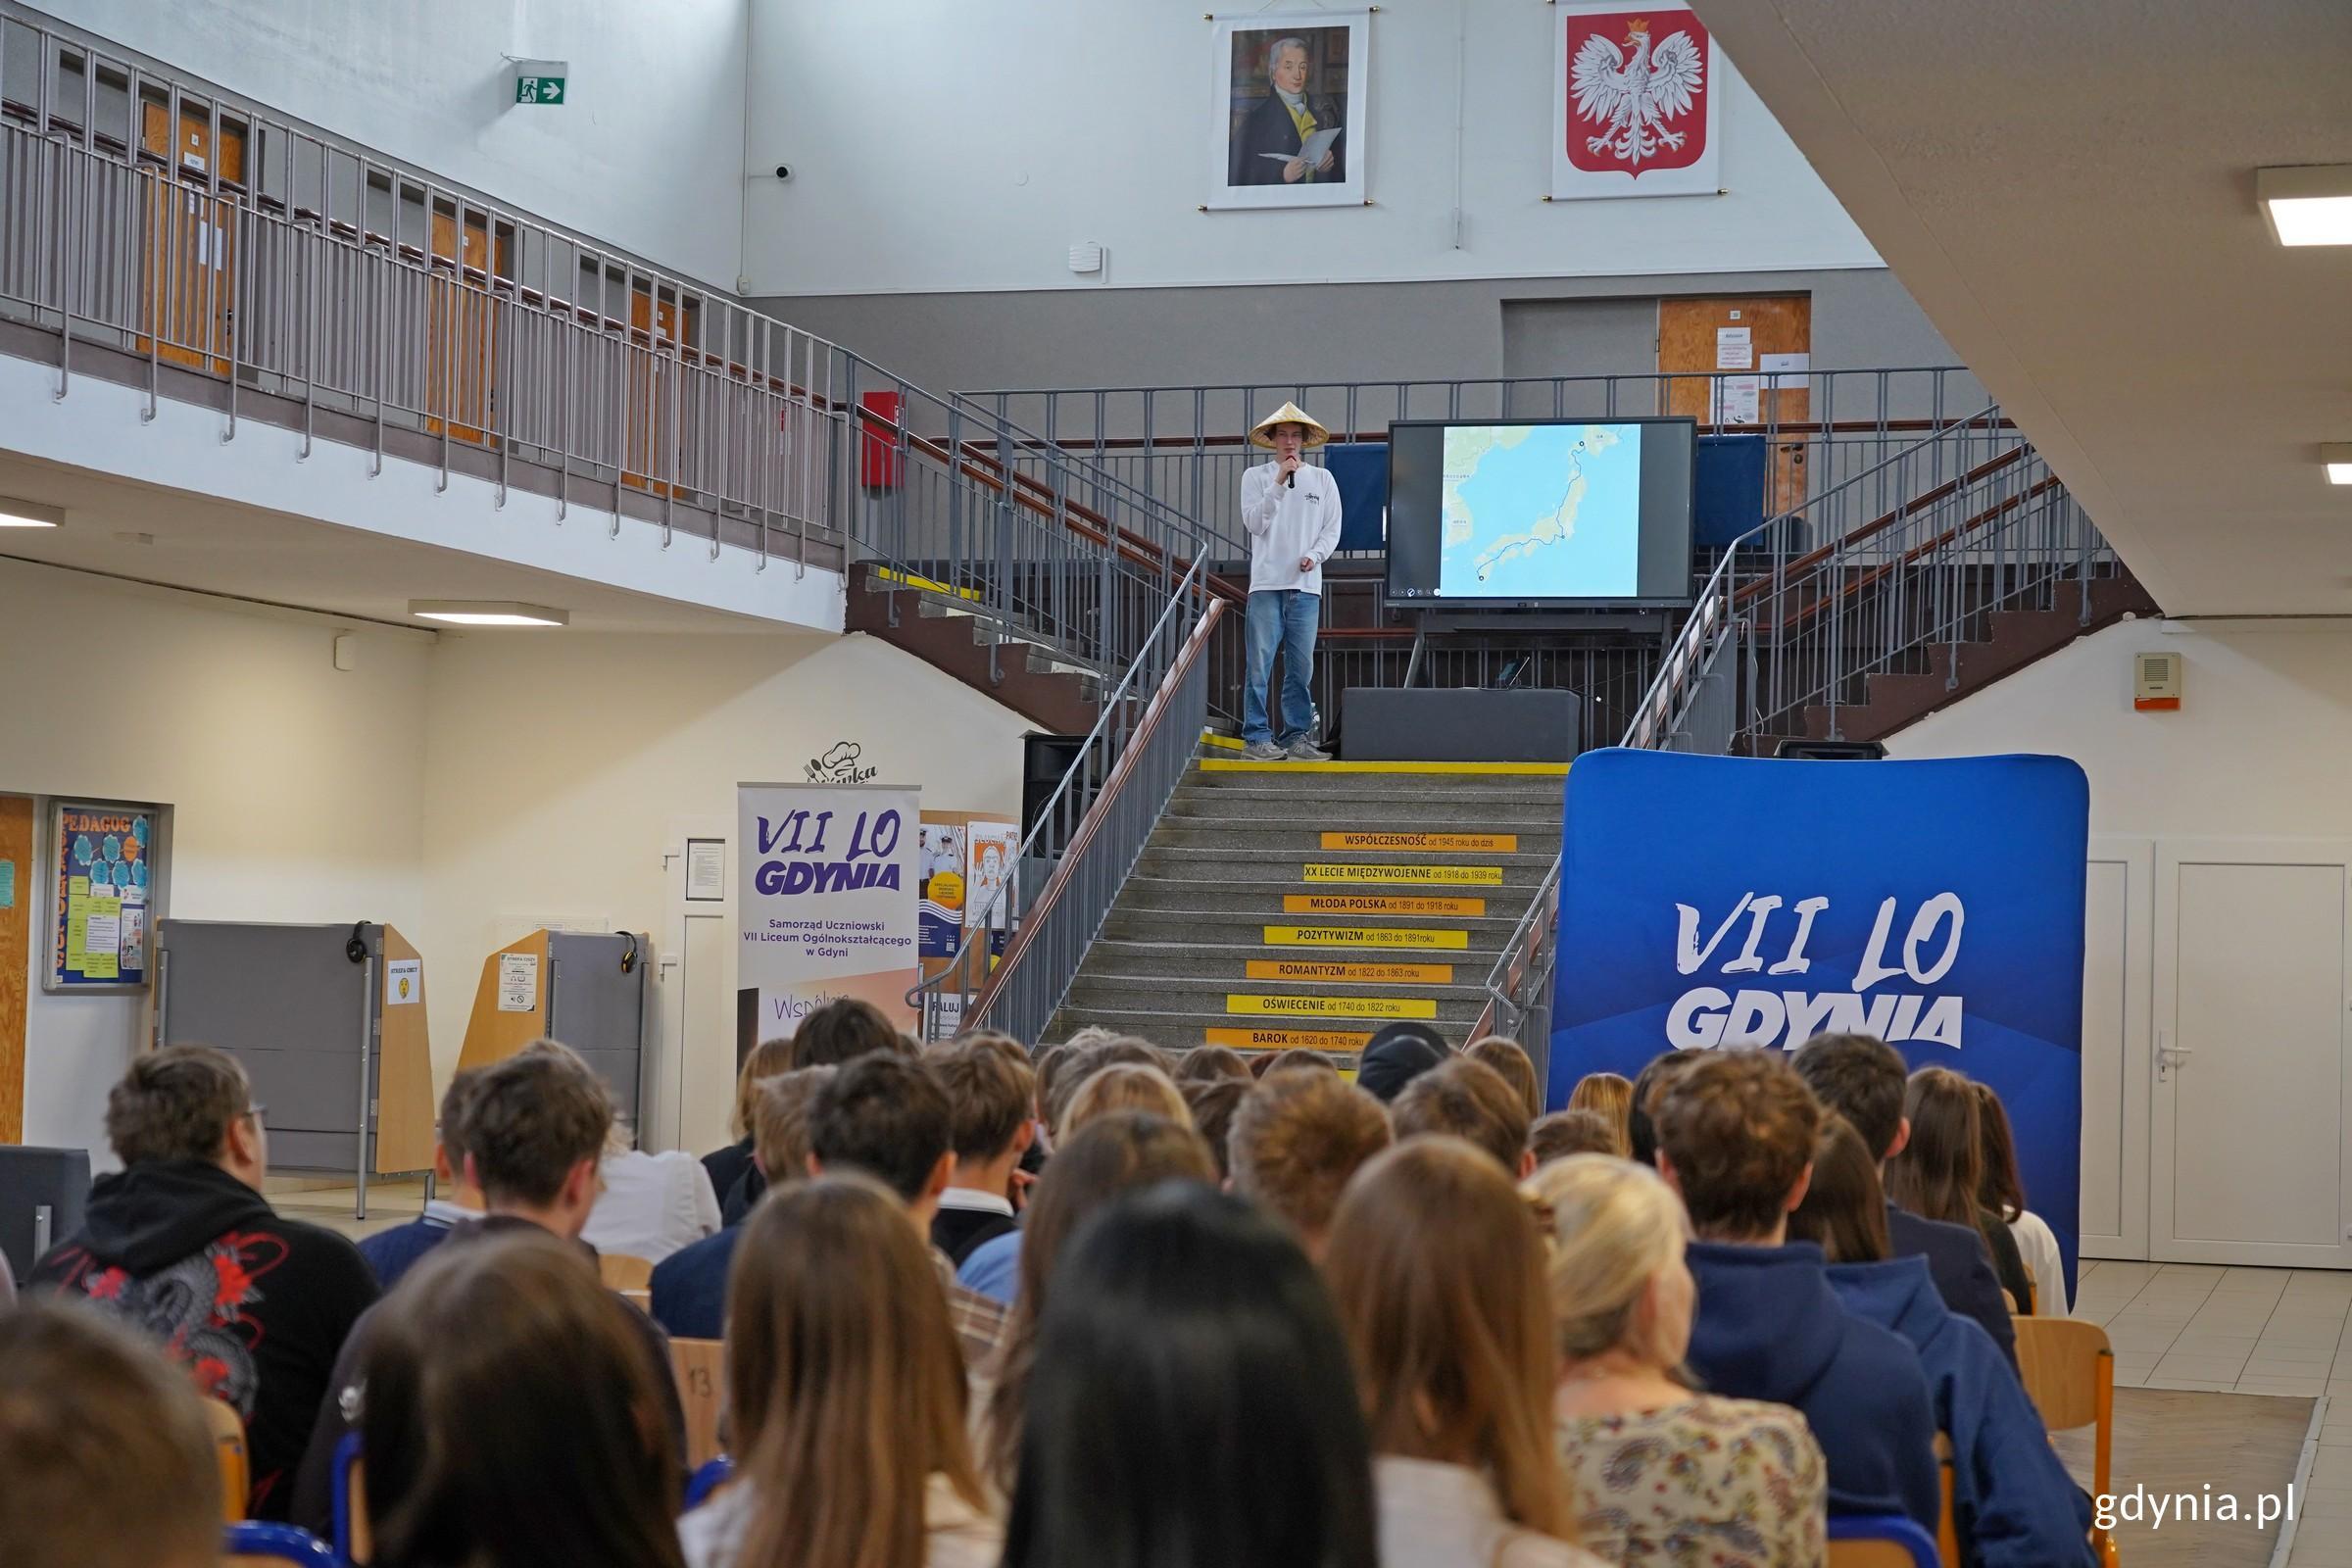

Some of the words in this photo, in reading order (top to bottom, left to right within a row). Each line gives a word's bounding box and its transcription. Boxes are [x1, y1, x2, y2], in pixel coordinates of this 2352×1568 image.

[757, 809, 833, 855] VII
[846, 808, 901, 862] LO
[1346, 833, 1427, 846] WSPÓŁCZESNOŚĆ
[1439, 838, 1454, 847] 1945
[1455, 838, 1470, 847] roku
[1471, 838, 1480, 847] do
[755, 860, 900, 896] GDYNIA
[1305, 866, 1317, 876] XX
[1320, 867, 1345, 877] LECIE
[1348, 867, 1431, 879] MIĘDZYWOJENNE
[1445, 870, 1458, 879] 1918
[1460, 870, 1468, 879] do
[1471, 870, 1487, 879] 1939
[1488, 871, 1501, 880] roku
[1310, 899, 1347, 908] MŁODA
[1349, 899, 1387, 908] POLSKA
[1416, 902, 1425, 910] do
[1427, 902, 1443, 910] 1918
[1445, 902, 1458, 910] roku
[769, 919, 822, 931] Samorząd
[825, 920, 885, 931] Uczniowski
[744, 933, 758, 942] VII
[760, 933, 799, 943] Liceum
[803, 933, 911, 946] Ogólnokształcącego
[1298, 930, 1363, 941] POZYTYWIZM
[1366, 933, 1374, 942] od
[1377, 932, 1392, 942] 1863
[1394, 933, 1402, 942] do
[1675, 892, 1829, 976] VII
[1852, 892, 1965, 993] LO
[818, 948, 849, 958] Gdyni
[1279, 964, 1346, 976] ROMANTYZM
[1348, 968, 1356, 977] od
[1358, 967, 1375, 977] 1822
[1377, 968, 1386, 977] do
[1388, 968, 1403, 977] 1863
[1405, 968, 1419, 978] roku
[1263, 999, 1325, 1010] OŚWIECENIE
[1328, 1002, 1337, 1010] od
[1339, 1002, 1354, 1011] 1740
[1356, 1003, 1364, 1011] do
[1367, 1003, 1383, 1012] 1822
[1386, 1004, 1400, 1012] roku
[1666, 986, 1963, 1052] GDYNIA
[1253, 1033, 1288, 1044] BAROK
[1291, 1036, 1298, 1045] od
[1301, 1036, 1317, 1045] 1620
[1320, 1036, 1328, 1046] do
[1331, 1036, 1347, 1046] 1740
[1348, 1037, 1364, 1046] roku
